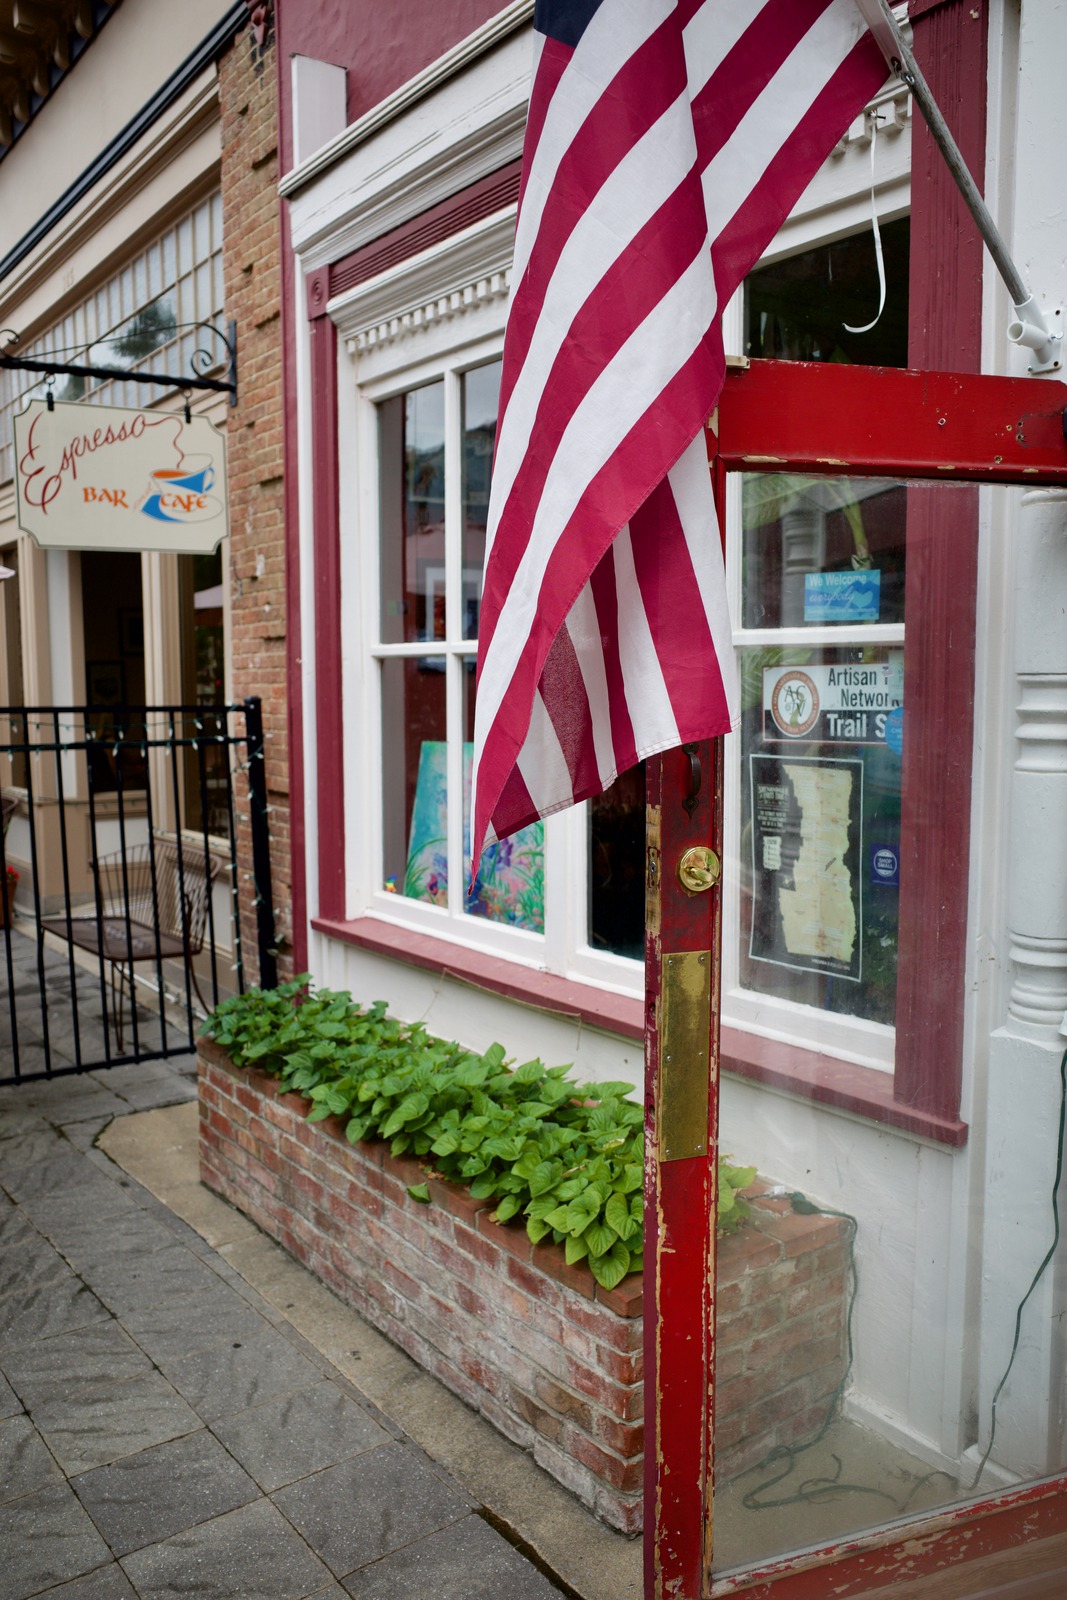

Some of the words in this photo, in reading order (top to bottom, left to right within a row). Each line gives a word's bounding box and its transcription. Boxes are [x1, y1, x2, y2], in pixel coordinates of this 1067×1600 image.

[20, 411, 147, 515] Espresso
[82, 486, 130, 509] BAR
[809, 575, 824, 587] We
[825, 574, 867, 586] Welcome
[808, 586, 855, 609] everybody
[828, 667, 877, 686] Artisan
[826, 712, 867, 737] Trail
